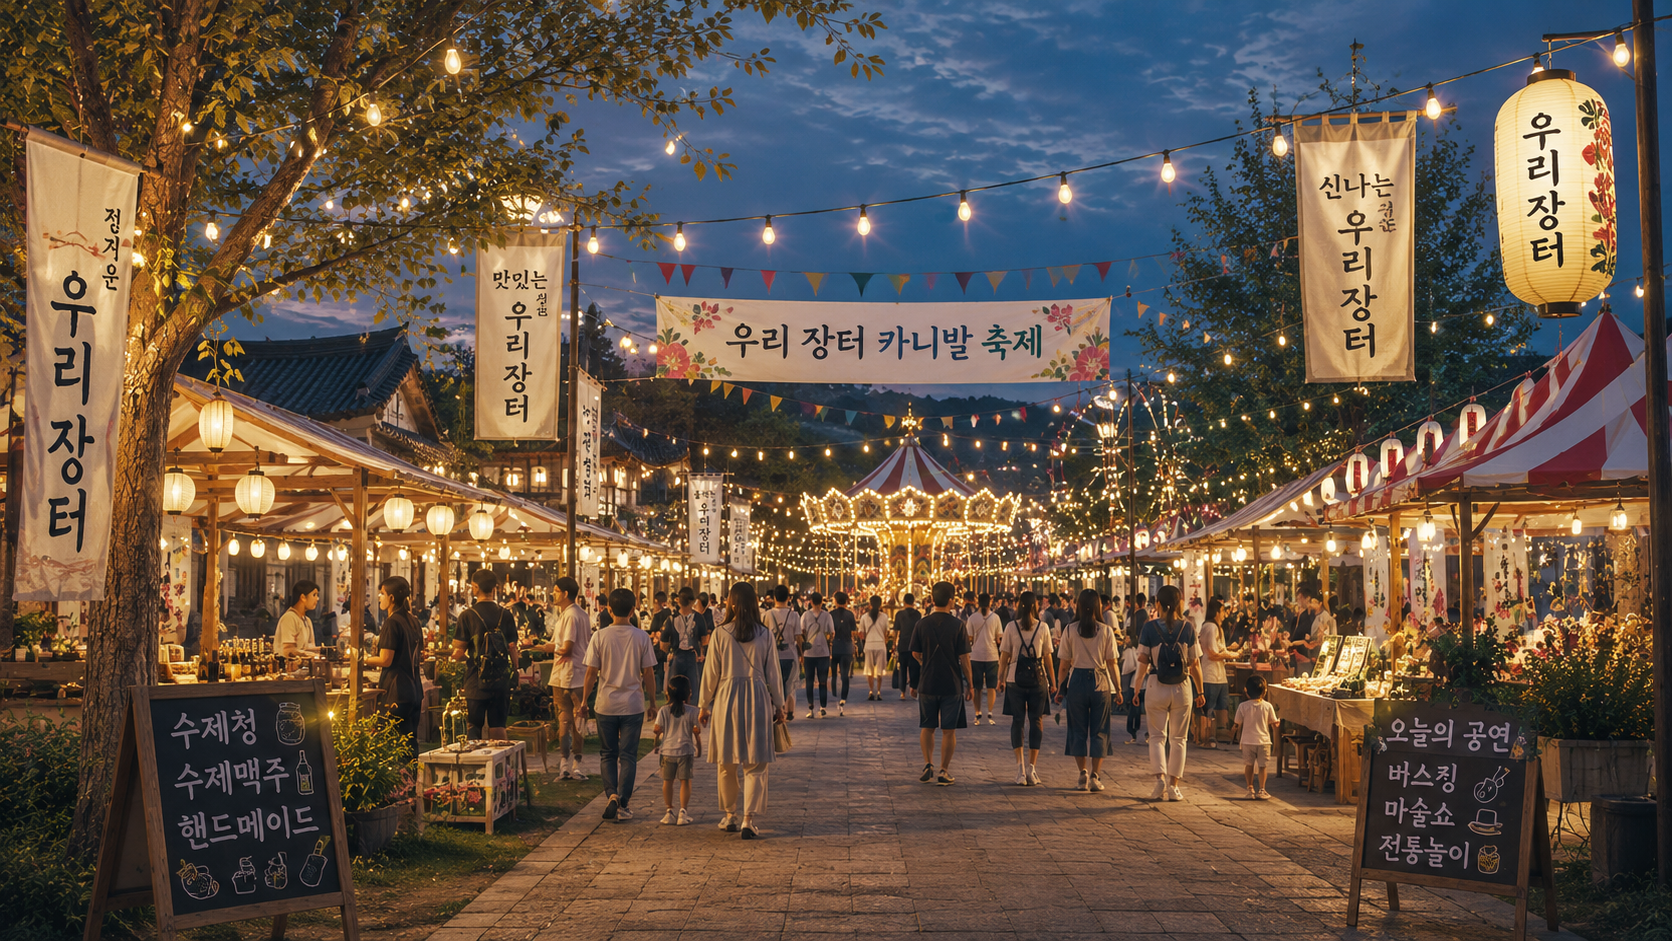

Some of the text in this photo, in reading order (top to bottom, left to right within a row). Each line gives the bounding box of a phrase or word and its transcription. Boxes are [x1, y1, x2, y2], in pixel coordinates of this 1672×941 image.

[1319, 173, 1394, 200] 신나는
[1523, 112, 1566, 269] 우리장터
[102, 208, 121, 291] 정지운
[1337, 210, 1378, 359] 우리장터
[503, 301, 533, 423] 우리장터
[725, 322, 1042, 361] 우리 장터 카니발 축제
[47, 270, 97, 553] 우리장터
[170, 708, 257, 749] 수제청
[1386, 717, 1511, 753] 오늘의 공연
[174, 757, 290, 800] 수제맥주
[1388, 761, 1458, 793] 버스킹
[177, 805, 319, 850] 핸드메이드
[1384, 797, 1456, 828] 마술쇼
[1378, 833, 1470, 870] 전통놀이
